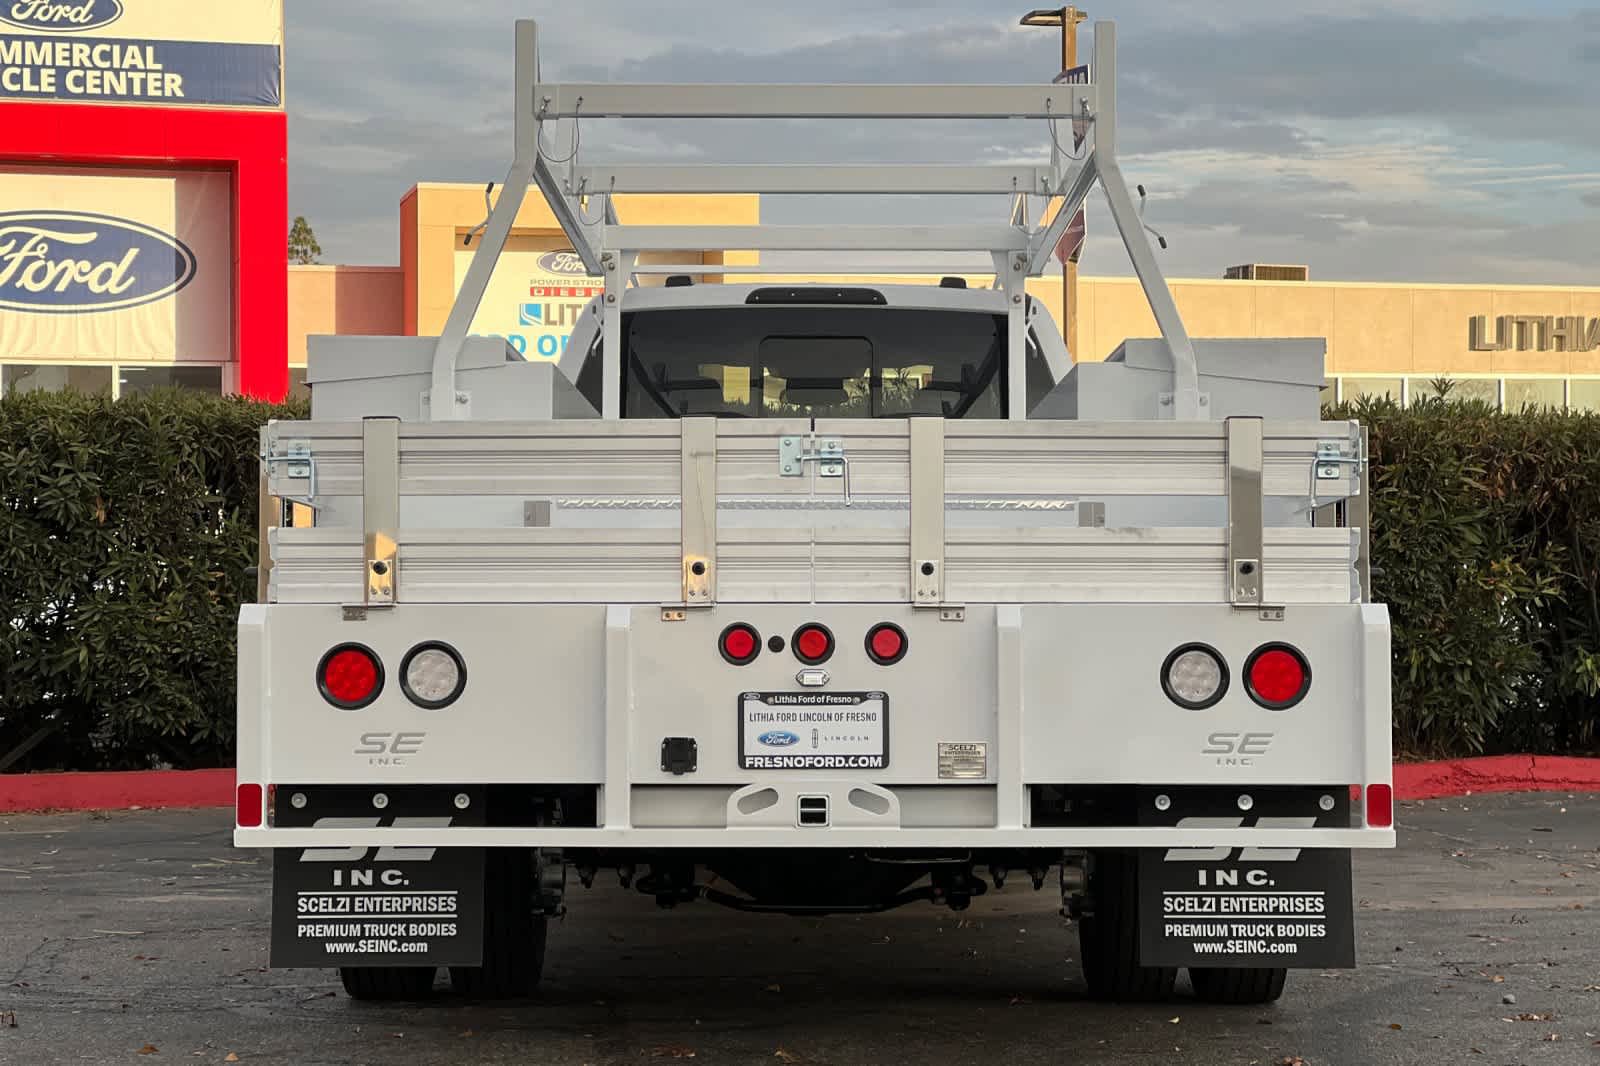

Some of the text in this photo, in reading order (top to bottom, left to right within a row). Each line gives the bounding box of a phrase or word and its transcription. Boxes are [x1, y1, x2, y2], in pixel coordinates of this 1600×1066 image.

[2, 67, 184, 97] CLE CENTER
[0, 226, 140, 294] Ford
[551, 252, 586, 272] For
[774, 695, 852, 704] Lithia Ford of Fresno
[749, 712, 877, 722] LITHIA FORD LINCOLN OF FRESNO
[354, 732, 426, 754] SE
[765, 731, 791, 745] Ford
[1201, 732, 1274, 754] SE
[745, 757, 882, 768] FRESNOFORD.COM
[333, 869, 409, 886] INC.
[1198, 869, 1275, 886] INC.
[297, 896, 457, 913] SCELZI ENTERPRISES
[1163, 897, 1325, 913] SCELZI ENTERPRISES
[297, 923, 457, 937] PREMIUM TRUCK BODIES
[1165, 924, 1326, 937] PREMIUM TRUCK BODIES
[325, 939, 428, 953] www.SEINC.com
[1193, 940, 1297, 953] www.SEINC.com
